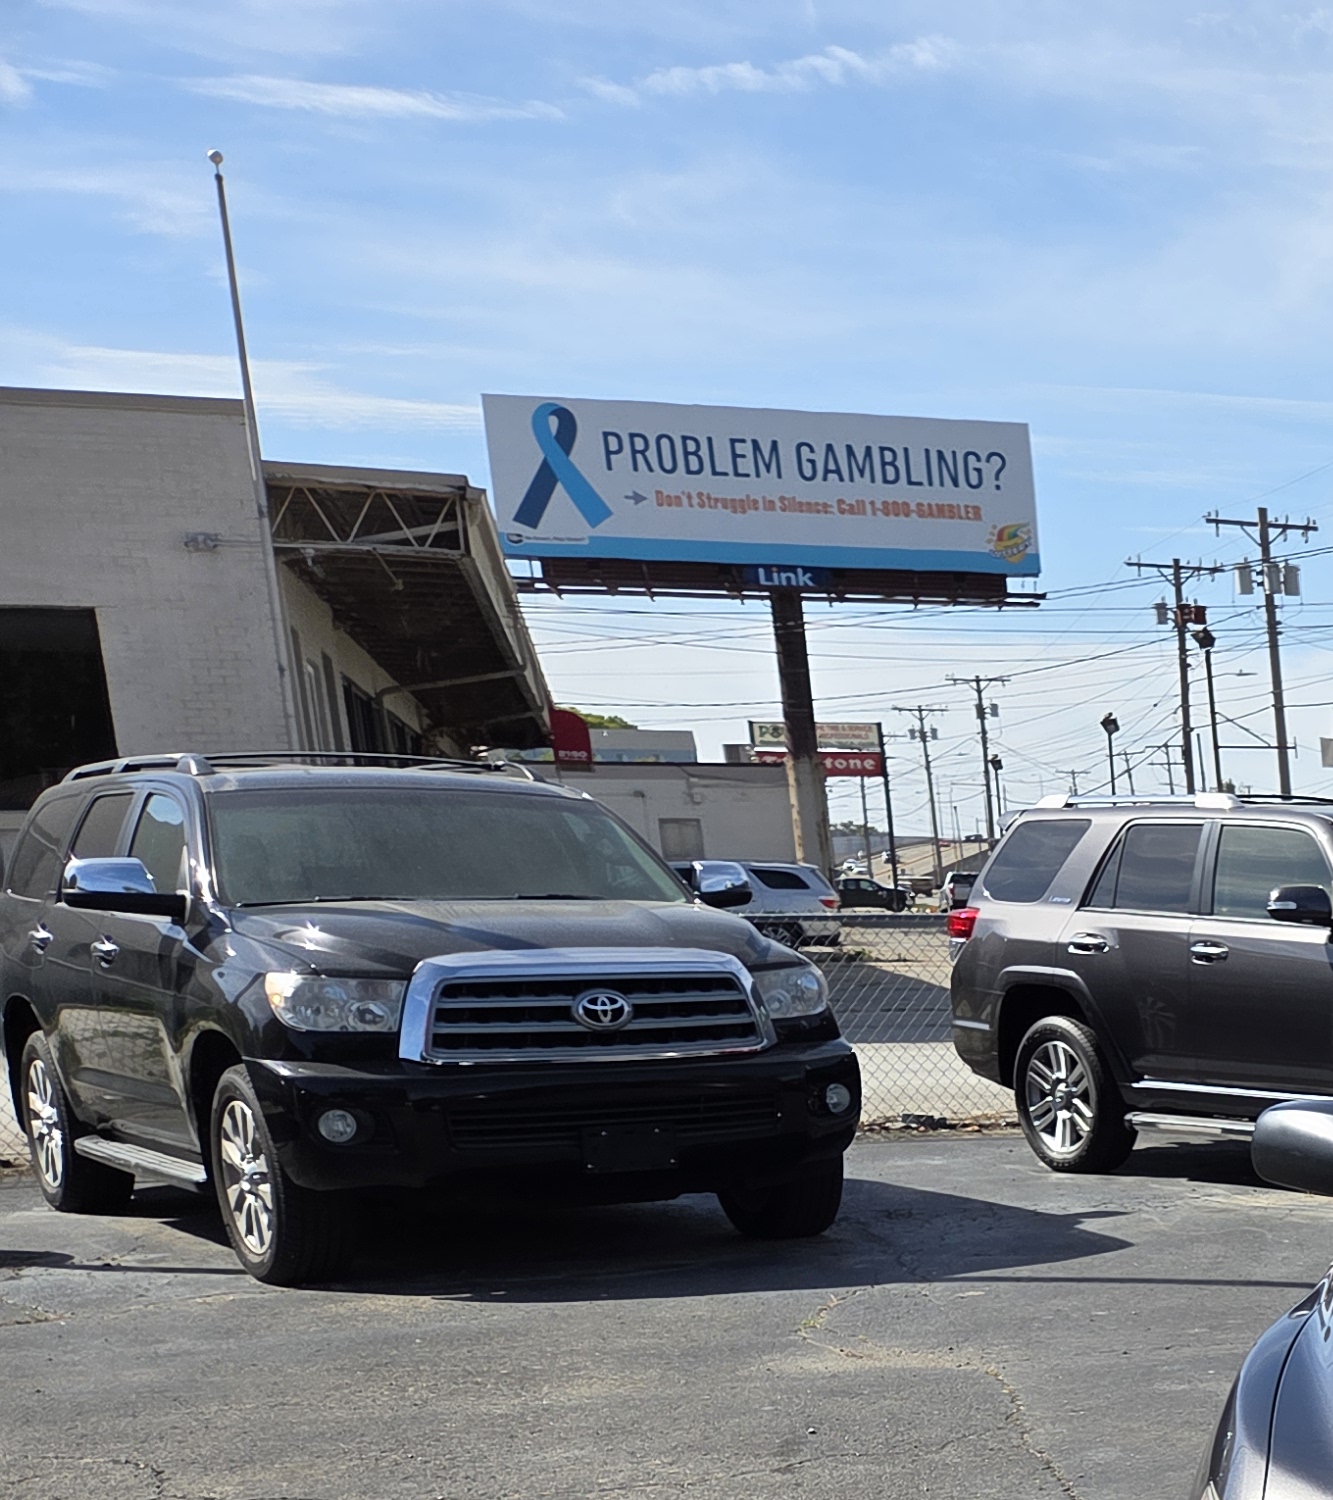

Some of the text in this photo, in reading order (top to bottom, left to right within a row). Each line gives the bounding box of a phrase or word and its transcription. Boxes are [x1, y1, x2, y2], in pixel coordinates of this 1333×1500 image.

[602, 431, 1006, 492] PROBLEM GAMBLING?
[655, 490, 694, 508] Don't
[696, 491, 760, 515] Struggle
[836, 498, 866, 516] Call
[758, 567, 817, 587] Link
